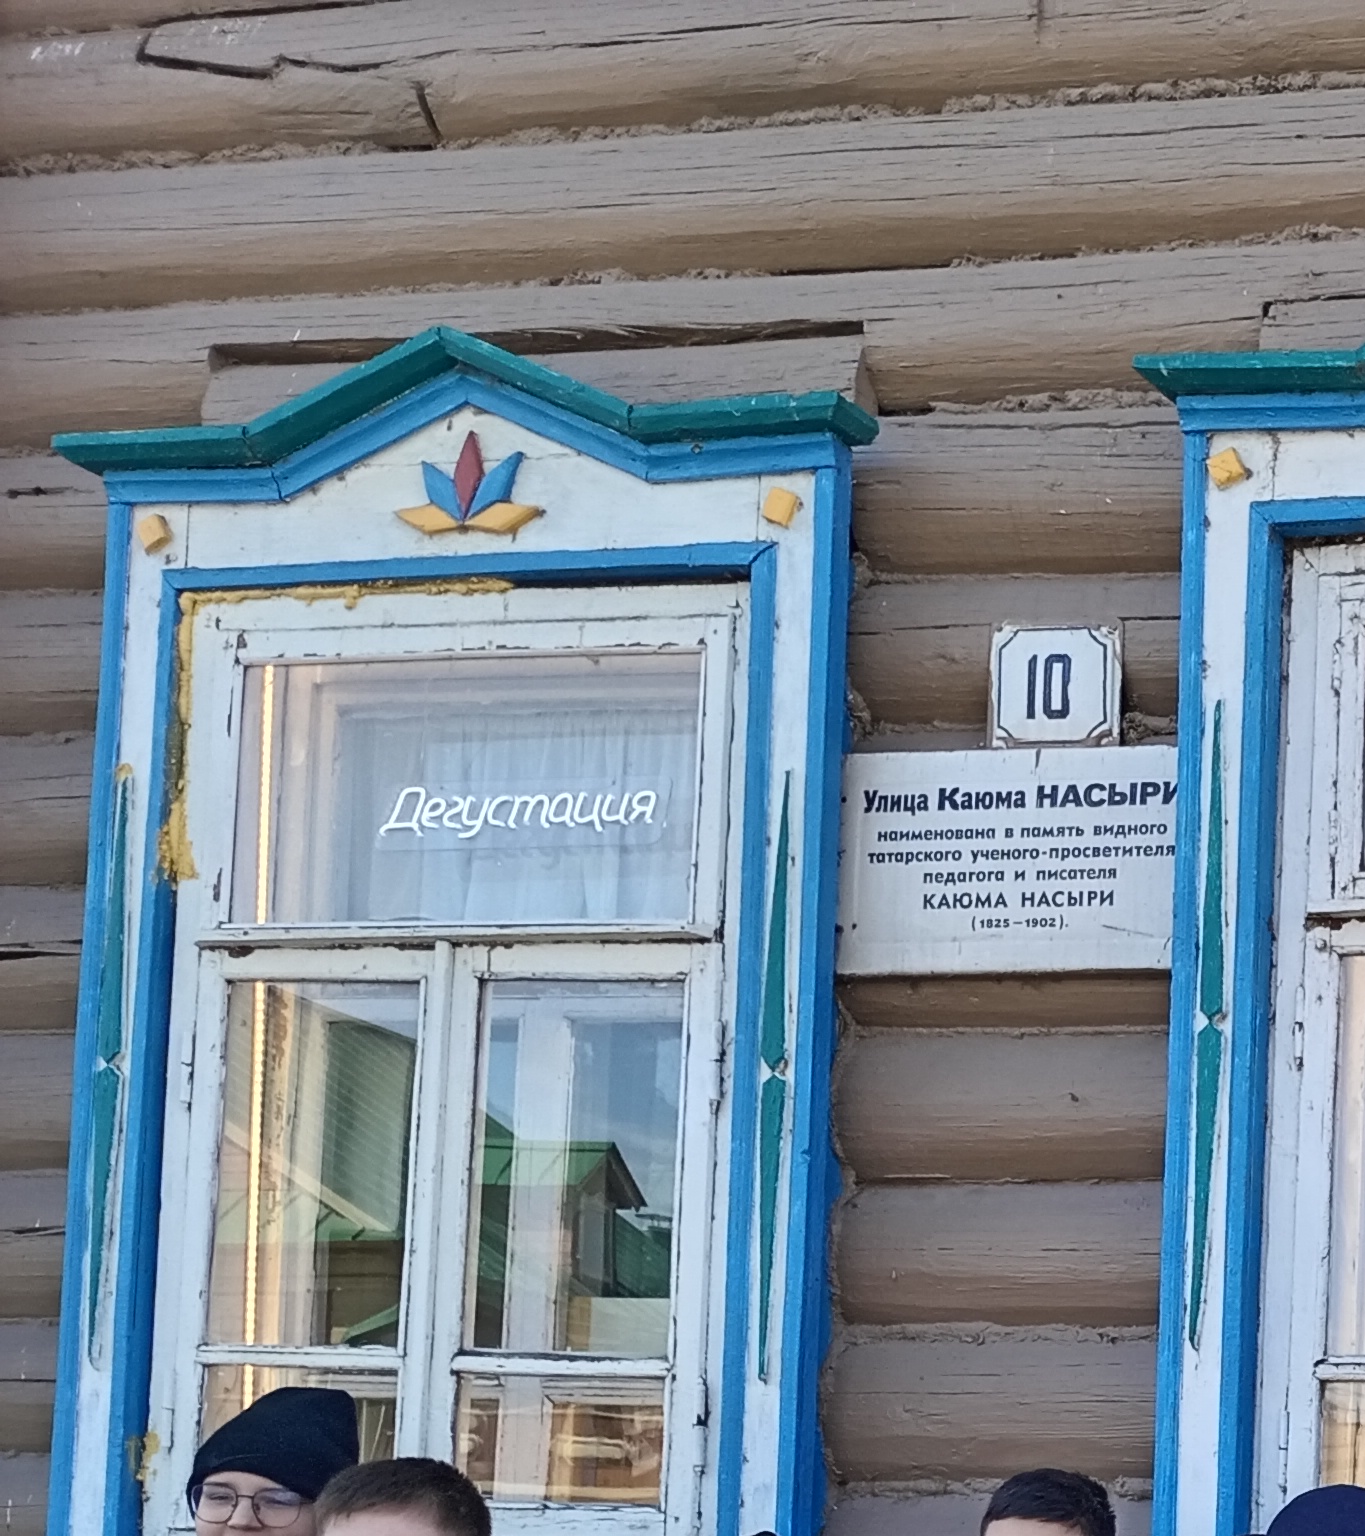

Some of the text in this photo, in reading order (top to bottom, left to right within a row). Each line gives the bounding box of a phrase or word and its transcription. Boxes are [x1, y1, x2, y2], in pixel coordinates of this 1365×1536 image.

[1026, 653, 1072, 720] 10
[378, 786, 657, 838] Дегустация
[863, 789, 930, 816] Улица
[937, 787, 1027, 812] Каюма
[877, 822, 1169, 843] наименована в память видного
[867, 848, 963, 866] татарского
[923, 867, 1118, 887] педагога и писателя
[923, 889, 1116, 911] КАЮМА НАСЫРИ
